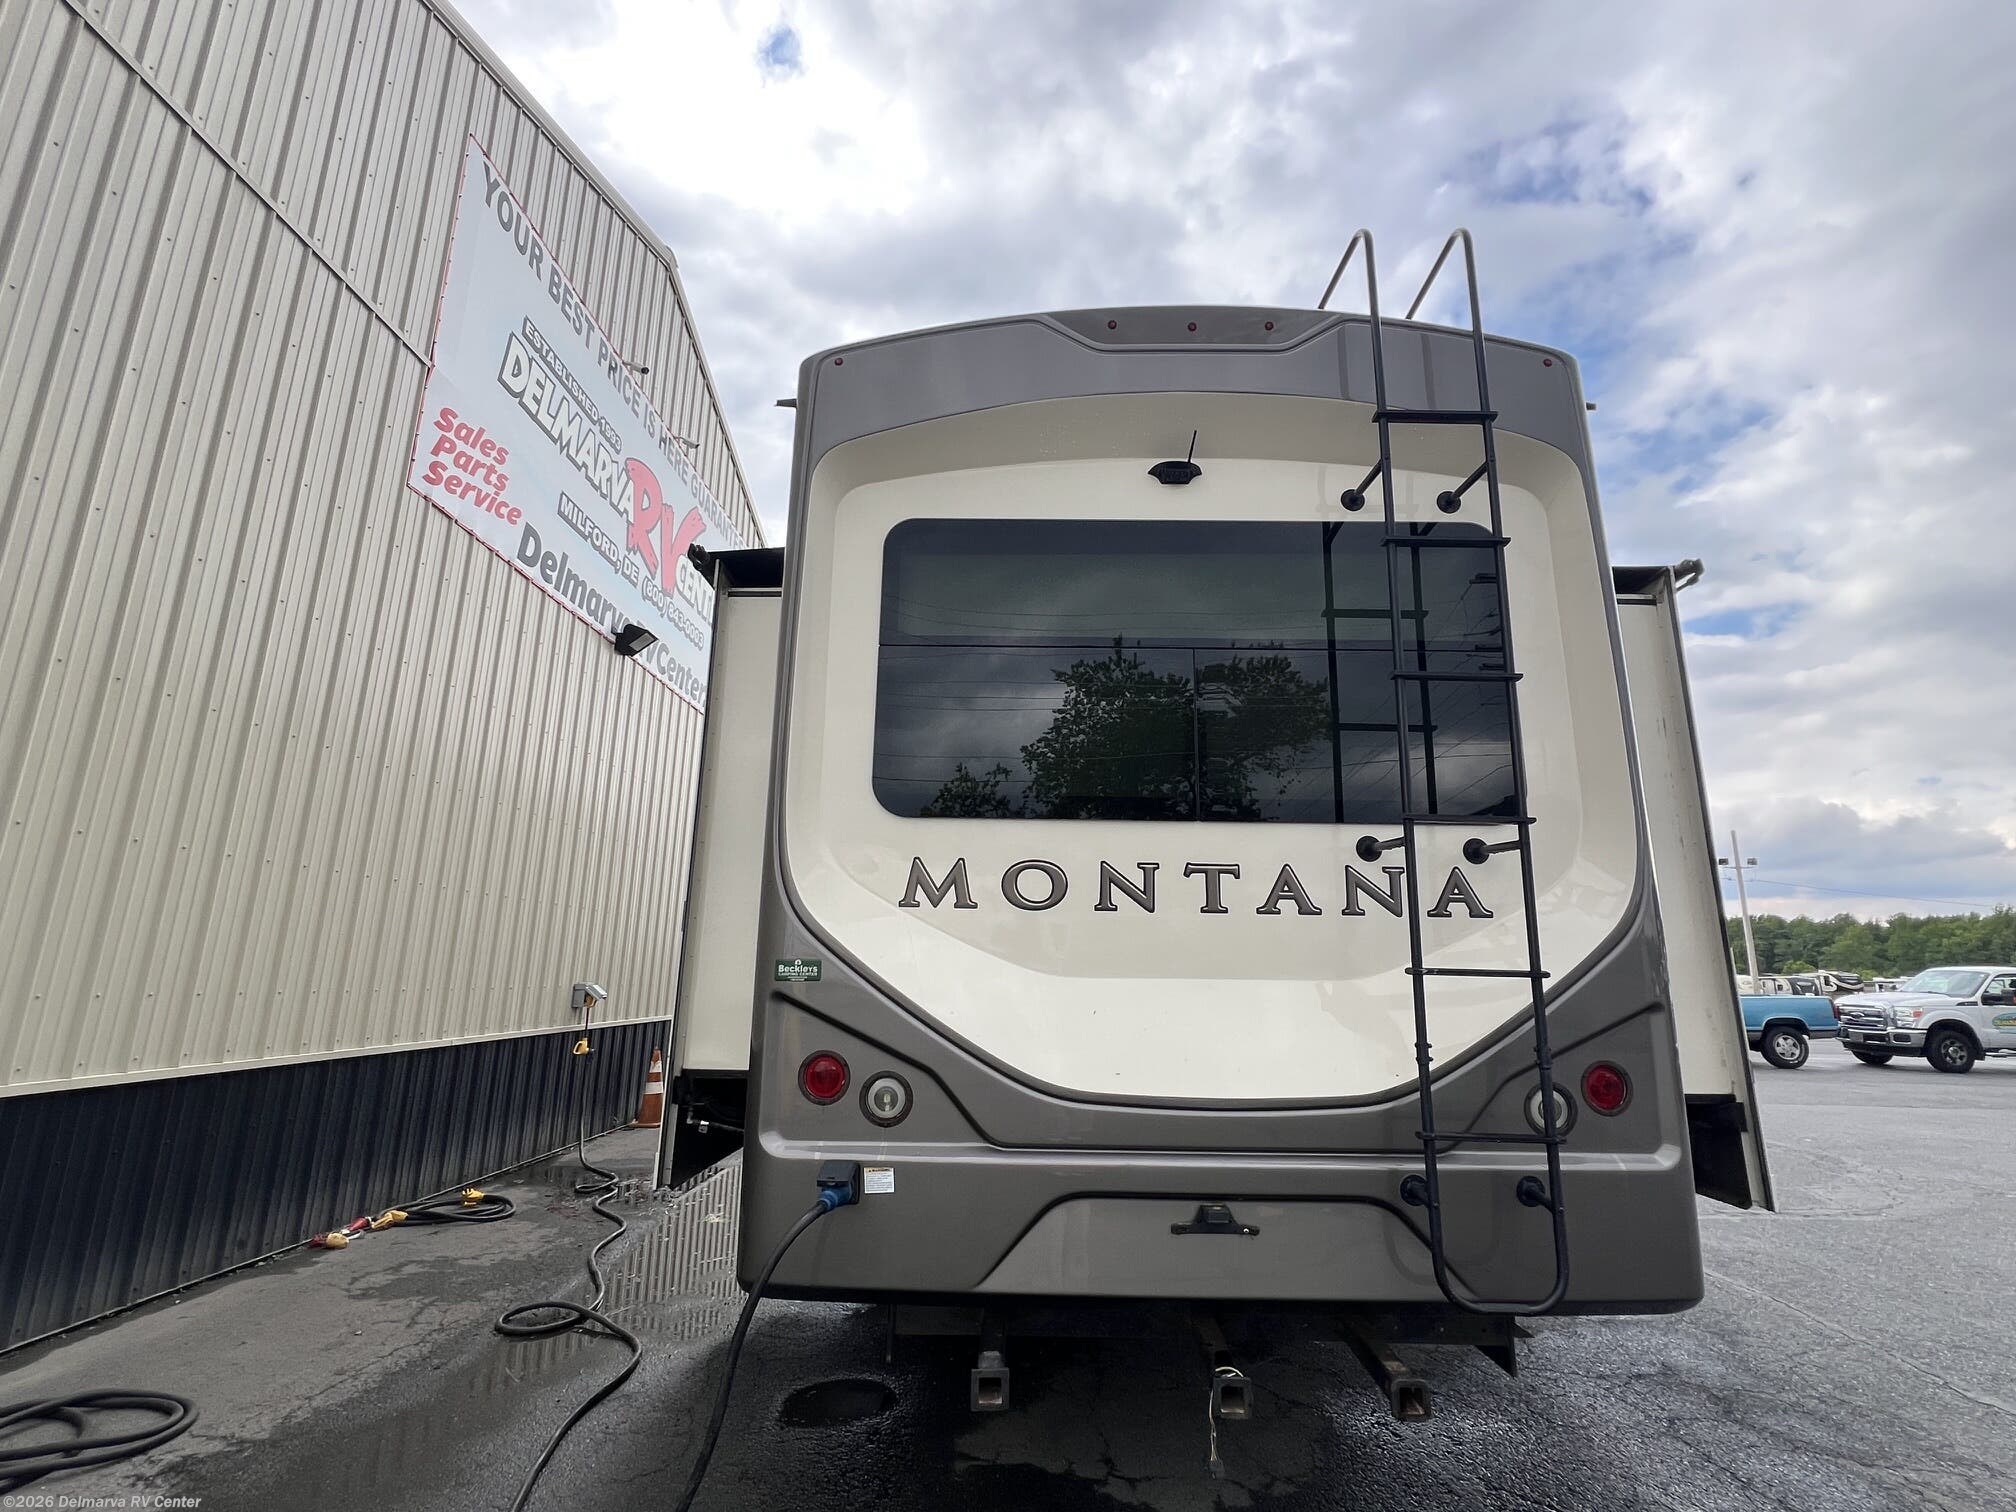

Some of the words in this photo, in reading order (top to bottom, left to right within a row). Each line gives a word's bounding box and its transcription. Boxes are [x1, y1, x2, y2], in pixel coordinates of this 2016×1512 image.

[483, 161, 544, 280] YOUR
[548, 264, 596, 349] BEST
[597, 337, 642, 418] PRICE
[643, 403, 656, 438] IS
[659, 424, 690, 486] HERE
[522, 316, 600, 425] ESTABLISHED
[430, 433, 510, 492] Parts
[433, 407, 510, 465] Sales
[497, 331, 635, 526] DELMARVA
[625, 457, 707, 597] RV
[422, 460, 522, 526] Service
[557, 490, 621, 574] MILFORD,
[621, 553, 640, 588] DE
[898, 855, 1495, 919] MONTANA
